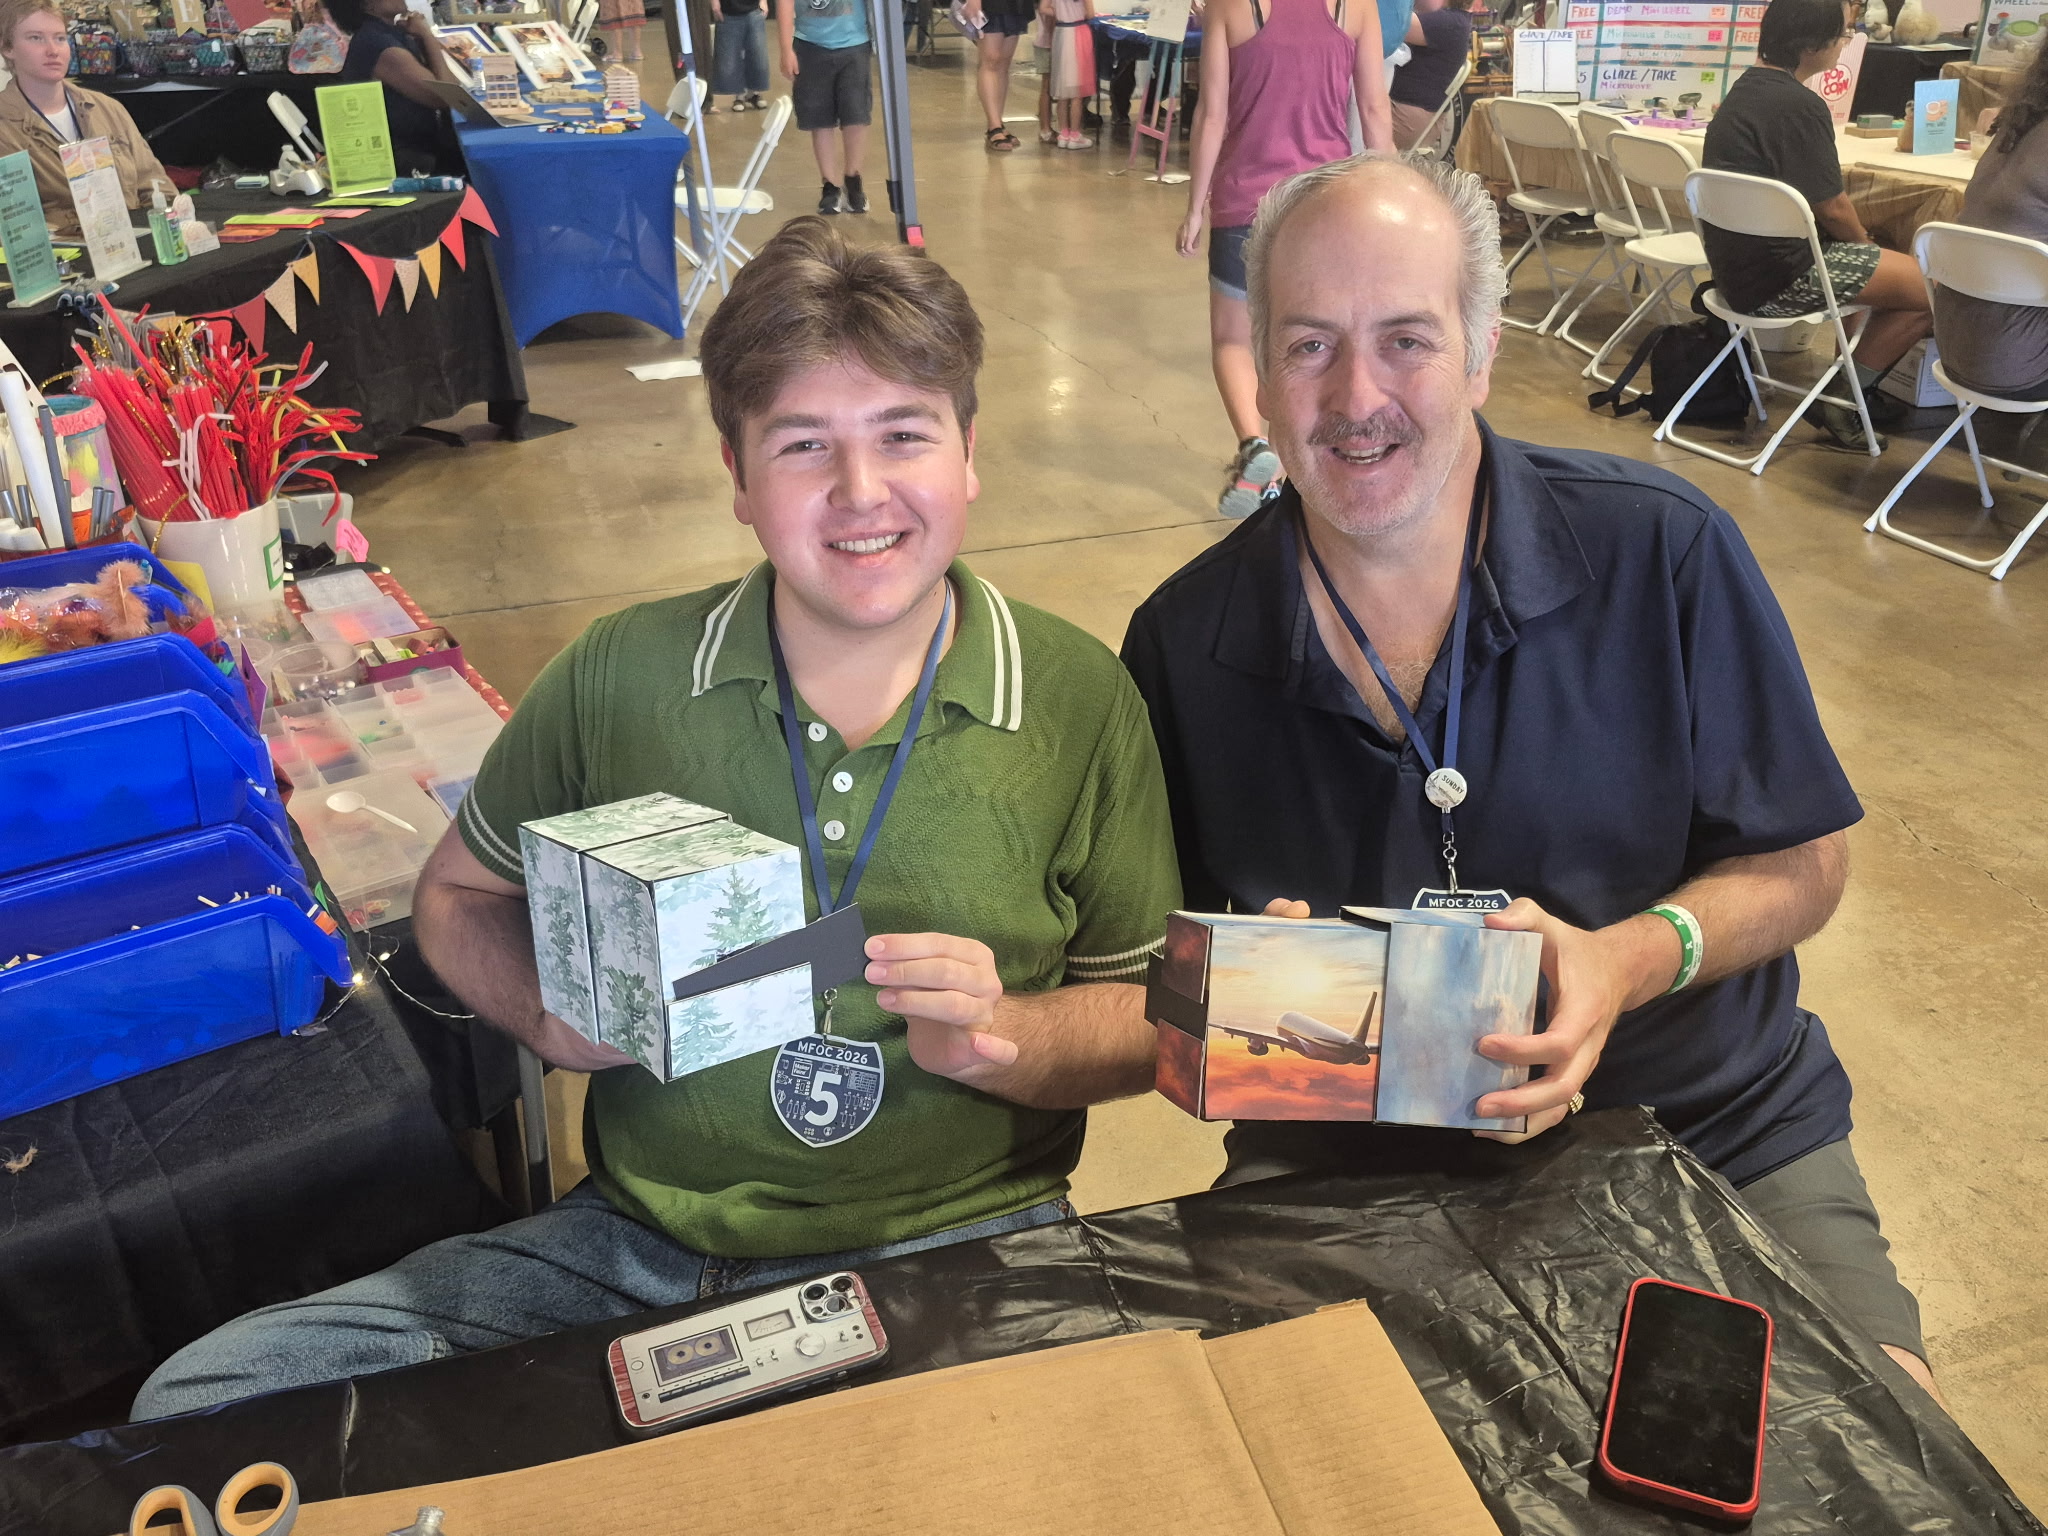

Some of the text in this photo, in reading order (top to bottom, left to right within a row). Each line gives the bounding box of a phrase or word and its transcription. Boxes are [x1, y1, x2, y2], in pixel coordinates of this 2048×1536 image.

[1572, 6, 1596, 18] FREE
[1607, 5, 1632, 15] DEMO
[1603, 69, 1637, 80] GLAZE
[1823, 68, 1844, 84] POP
[1823, 78, 1849, 96] CORN
[1441, 775, 1465, 794] SUNDAY
[1428, 898, 1499, 908] MFOC 2026
[797, 1041, 868, 1064] MFOC 2026
[804, 1070, 843, 1126] 5
